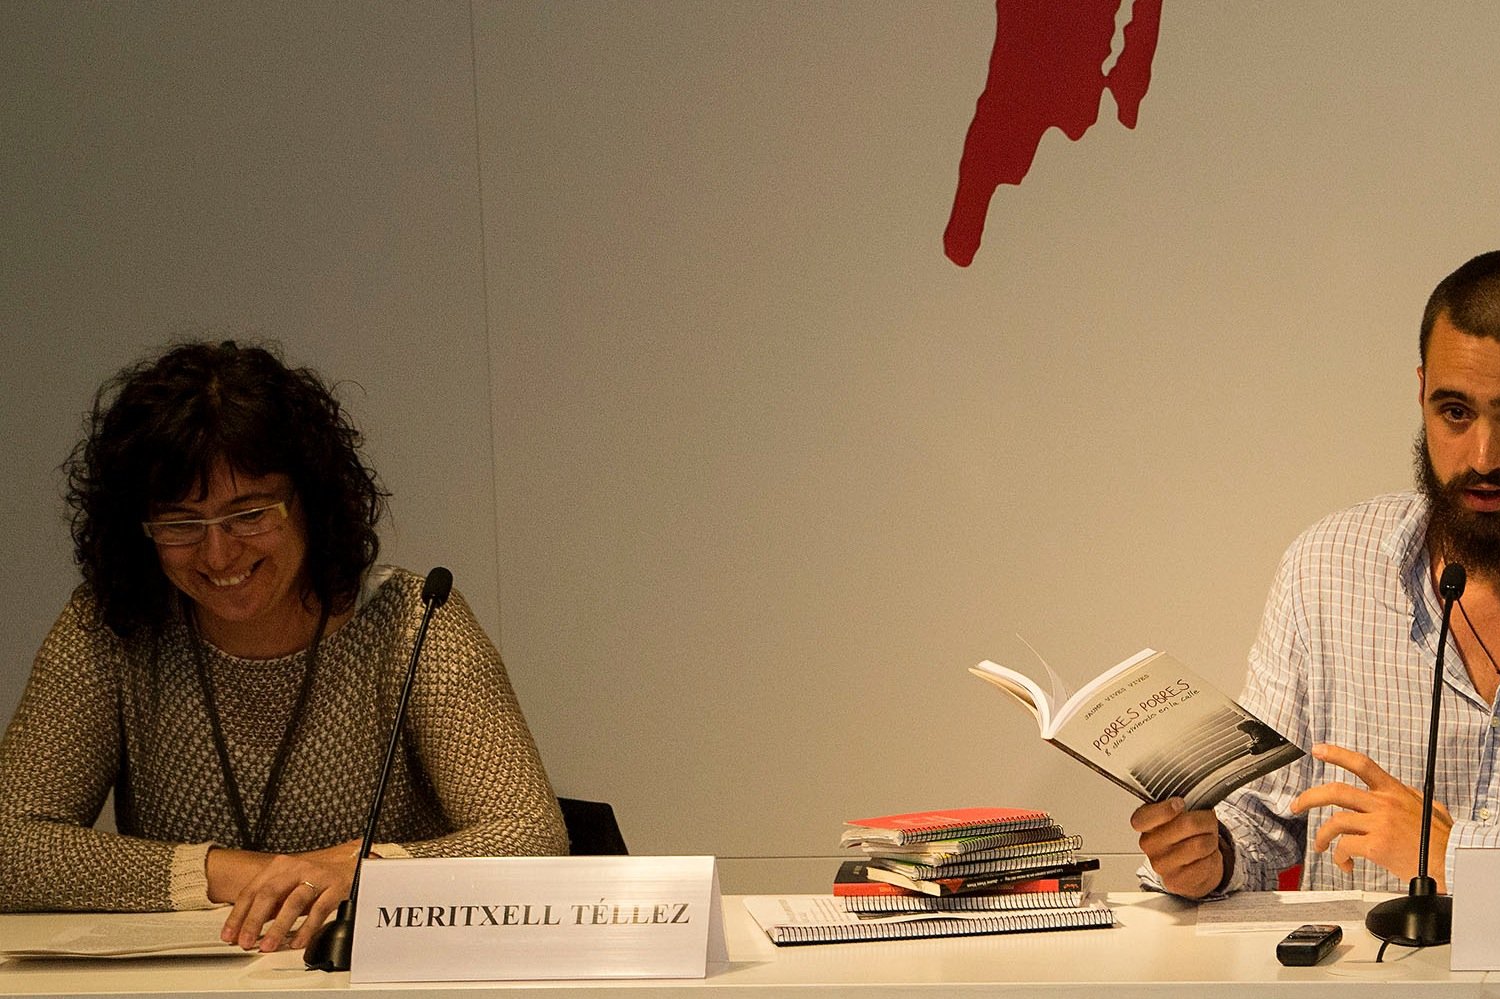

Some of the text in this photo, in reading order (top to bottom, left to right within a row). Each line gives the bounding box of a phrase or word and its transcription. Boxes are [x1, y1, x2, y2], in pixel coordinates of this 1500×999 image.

[1092, 678, 1190, 751] POBRES POBRES
[376, 897, 691, 928] MERITXELL TÉLLEZ
